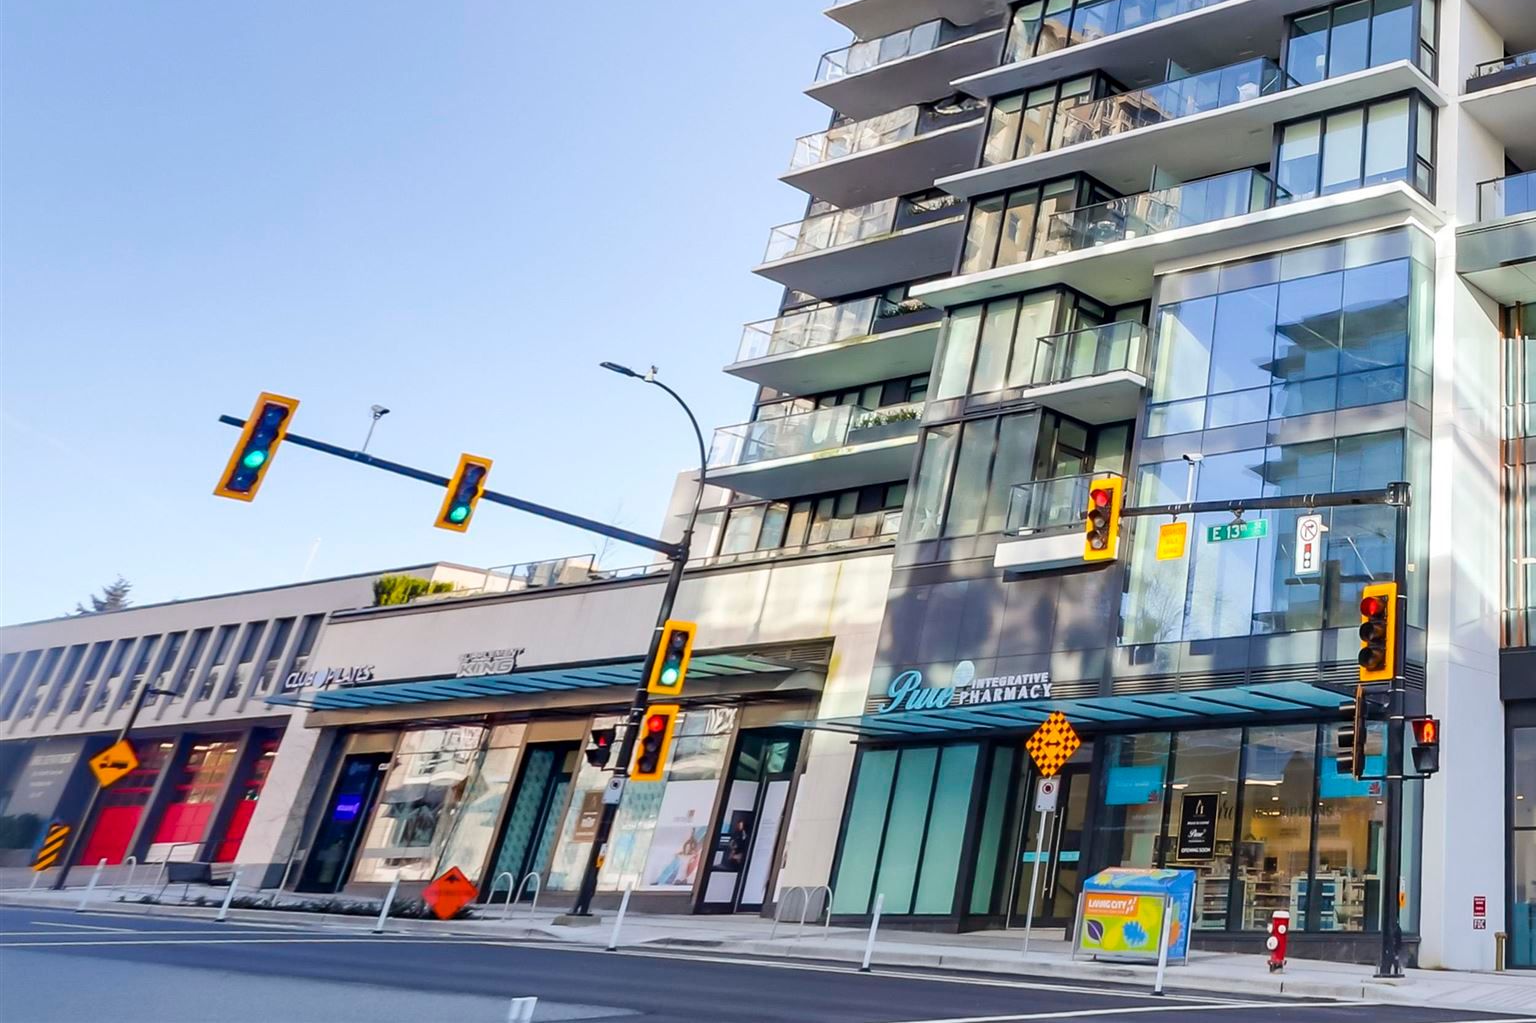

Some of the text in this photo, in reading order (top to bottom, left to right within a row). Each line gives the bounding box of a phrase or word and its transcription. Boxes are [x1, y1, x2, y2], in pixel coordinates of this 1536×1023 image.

[1212, 526, 1222, 541] E
[456, 658, 514, 678] KING
[972, 672, 1049, 689] INTEGRATIVE
[958, 683, 1053, 704] PHARMACY
